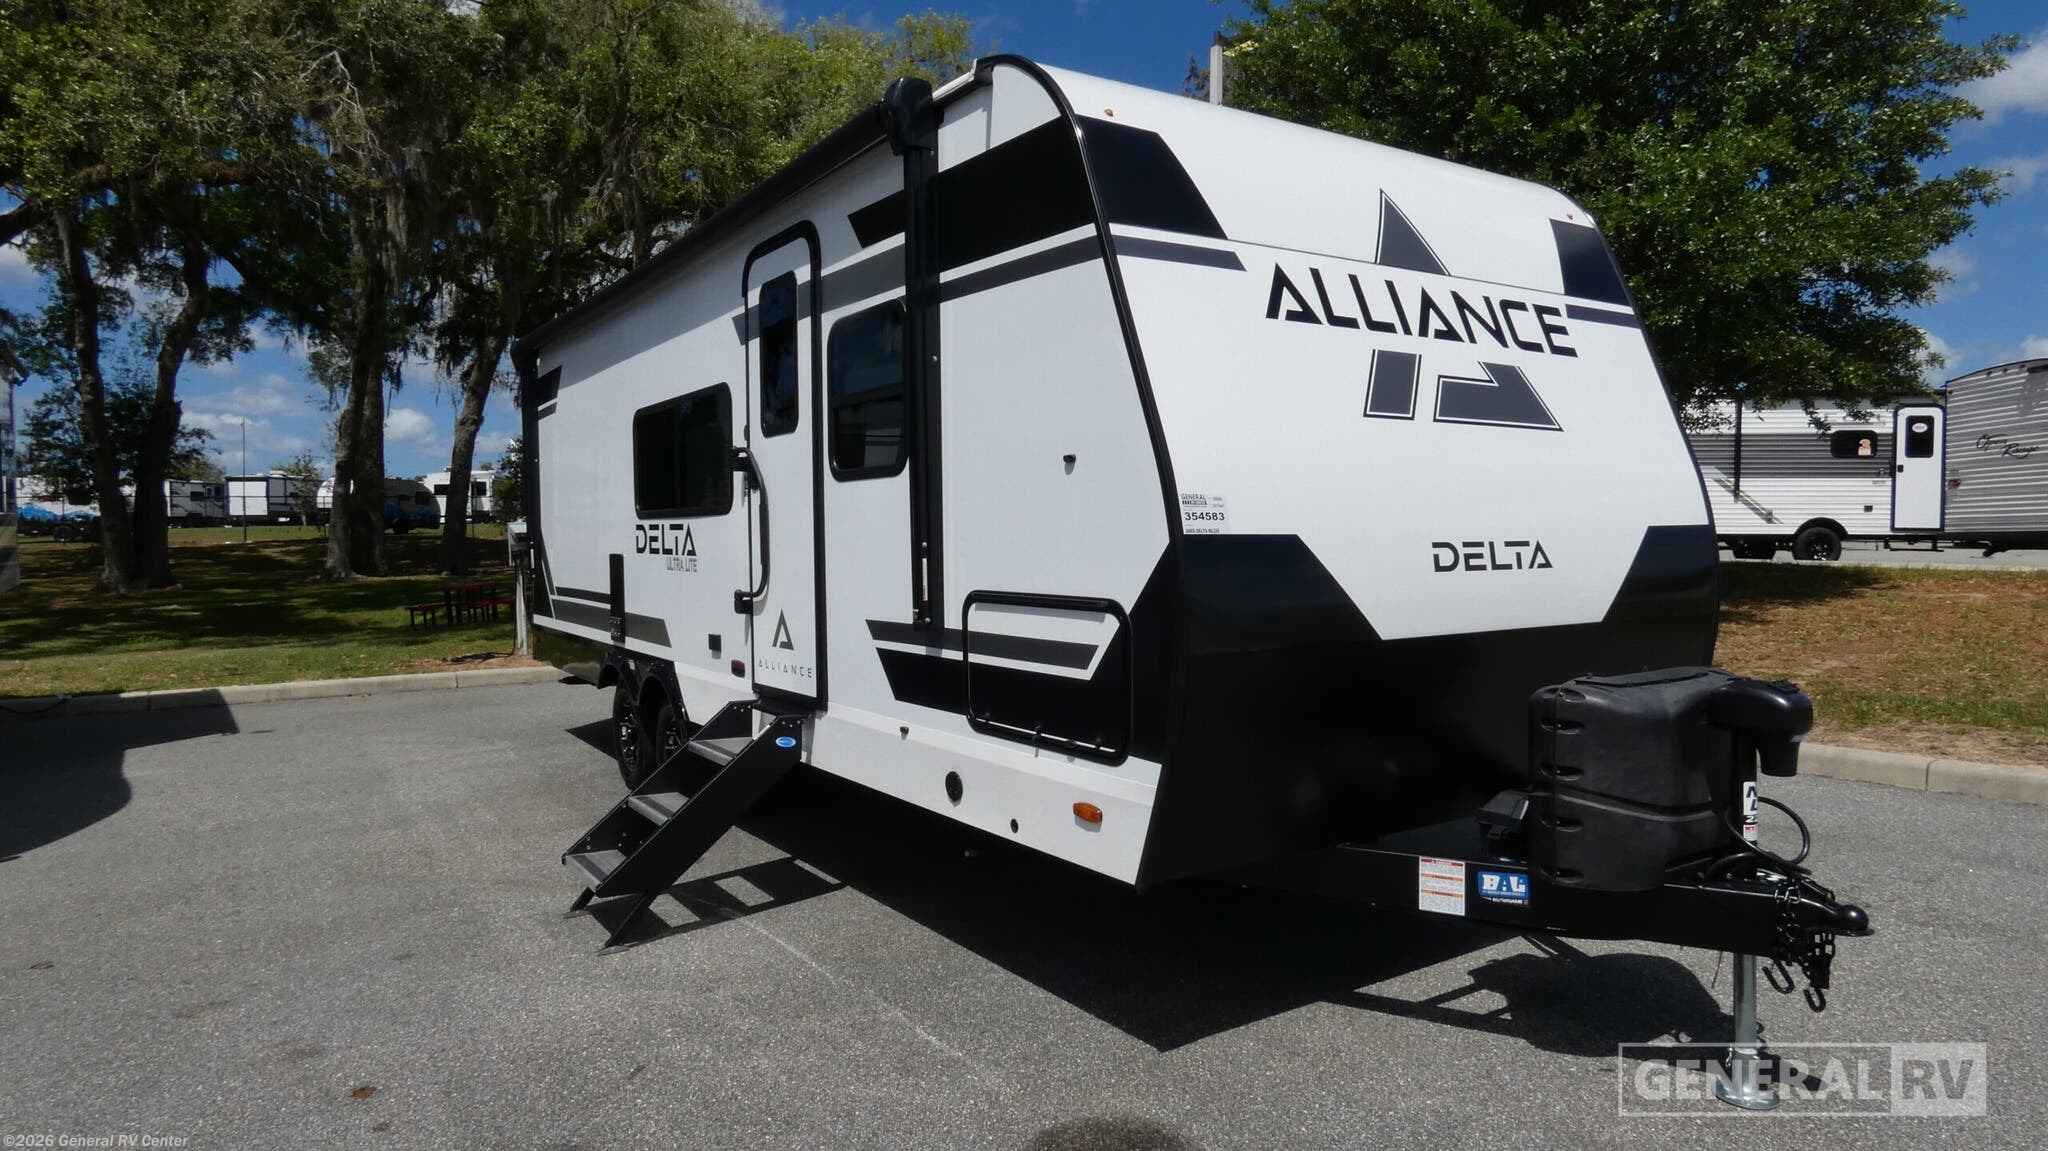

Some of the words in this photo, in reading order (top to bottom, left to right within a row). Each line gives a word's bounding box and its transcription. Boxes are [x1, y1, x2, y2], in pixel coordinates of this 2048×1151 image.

[1265, 262, 1578, 358] ALLIANCE
[1184, 512, 1225, 521] 354583
[636, 523, 697, 556] DELTA
[666, 557, 684, 572] ULTRA
[685, 558, 698, 573] LITE
[1432, 540, 1553, 572] DELTA
[759, 659, 812, 678] ALLIANCE
